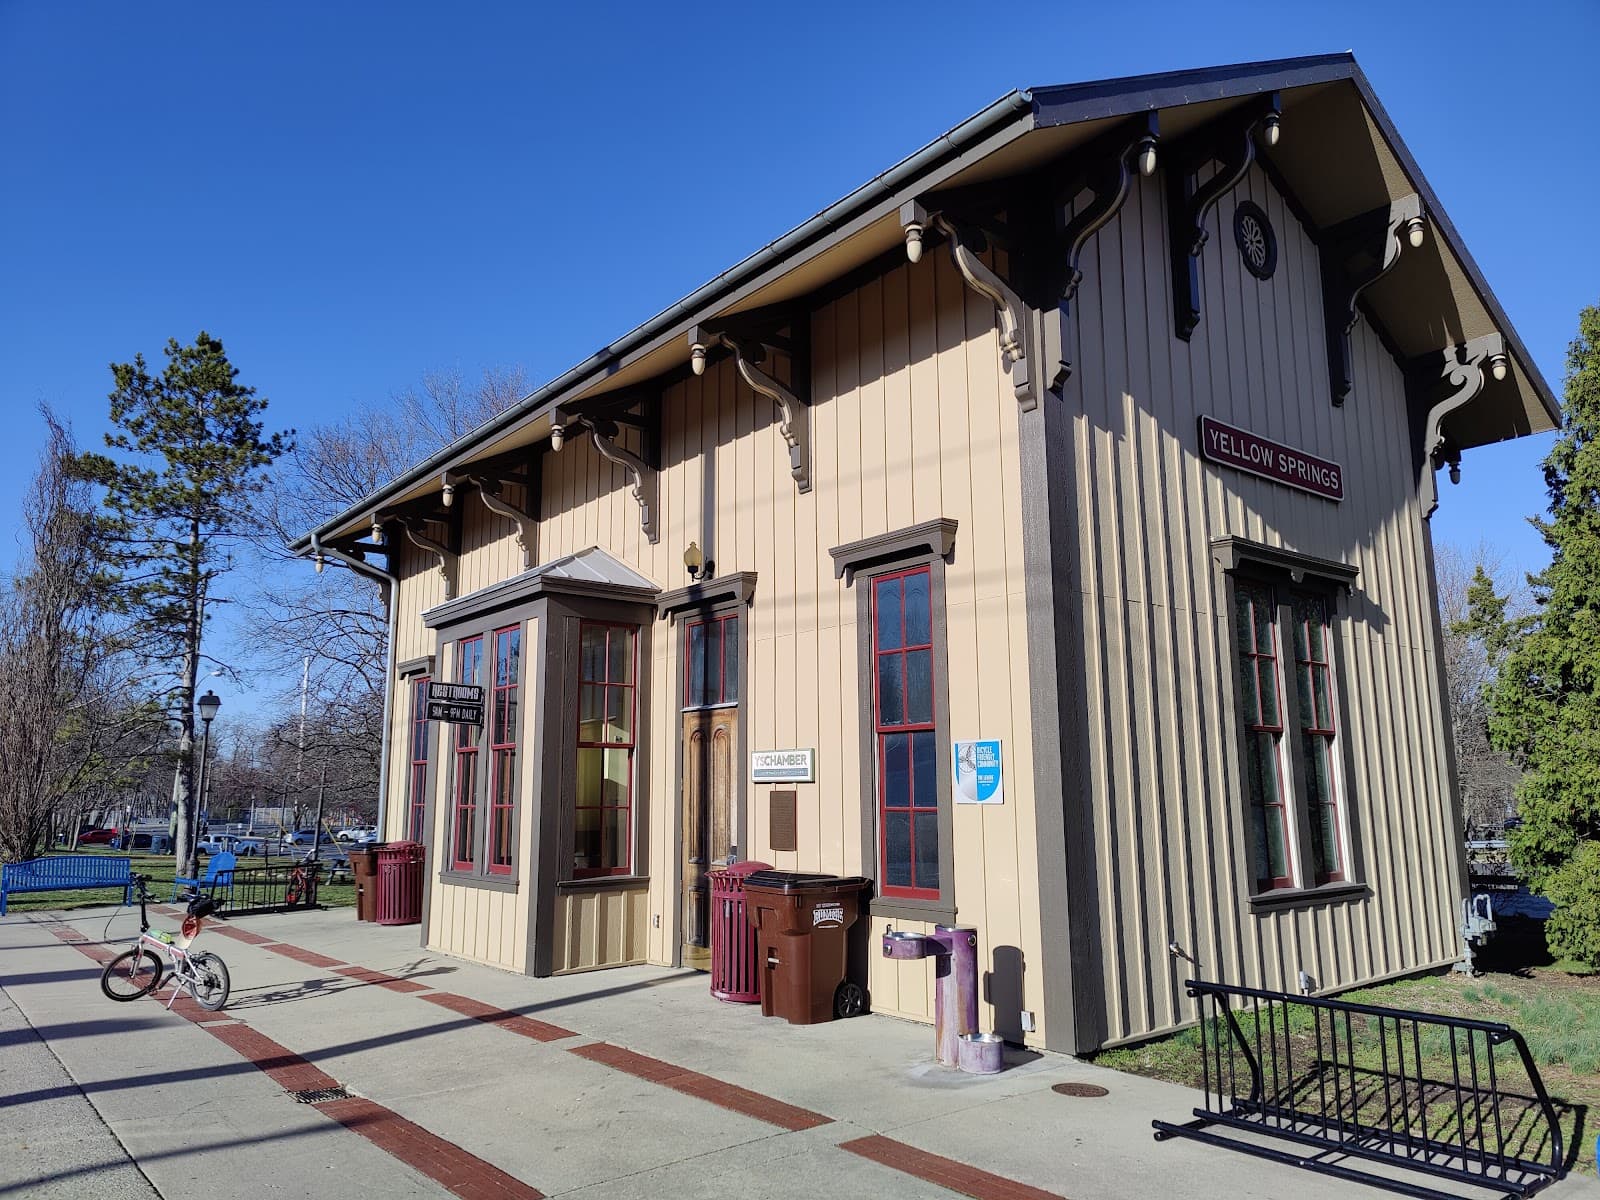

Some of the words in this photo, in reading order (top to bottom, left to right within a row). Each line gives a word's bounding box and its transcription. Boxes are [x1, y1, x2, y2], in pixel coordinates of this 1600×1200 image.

[1210, 429, 1273, 468] YELLOW
[1278, 453, 1339, 490] SPRINGS
[431, 684, 479, 700] RESTROOMS
[450, 707, 461, 719] 9PM
[461, 708, 477, 720] DAILY
[755, 754, 808, 767] YSCHAMBER
